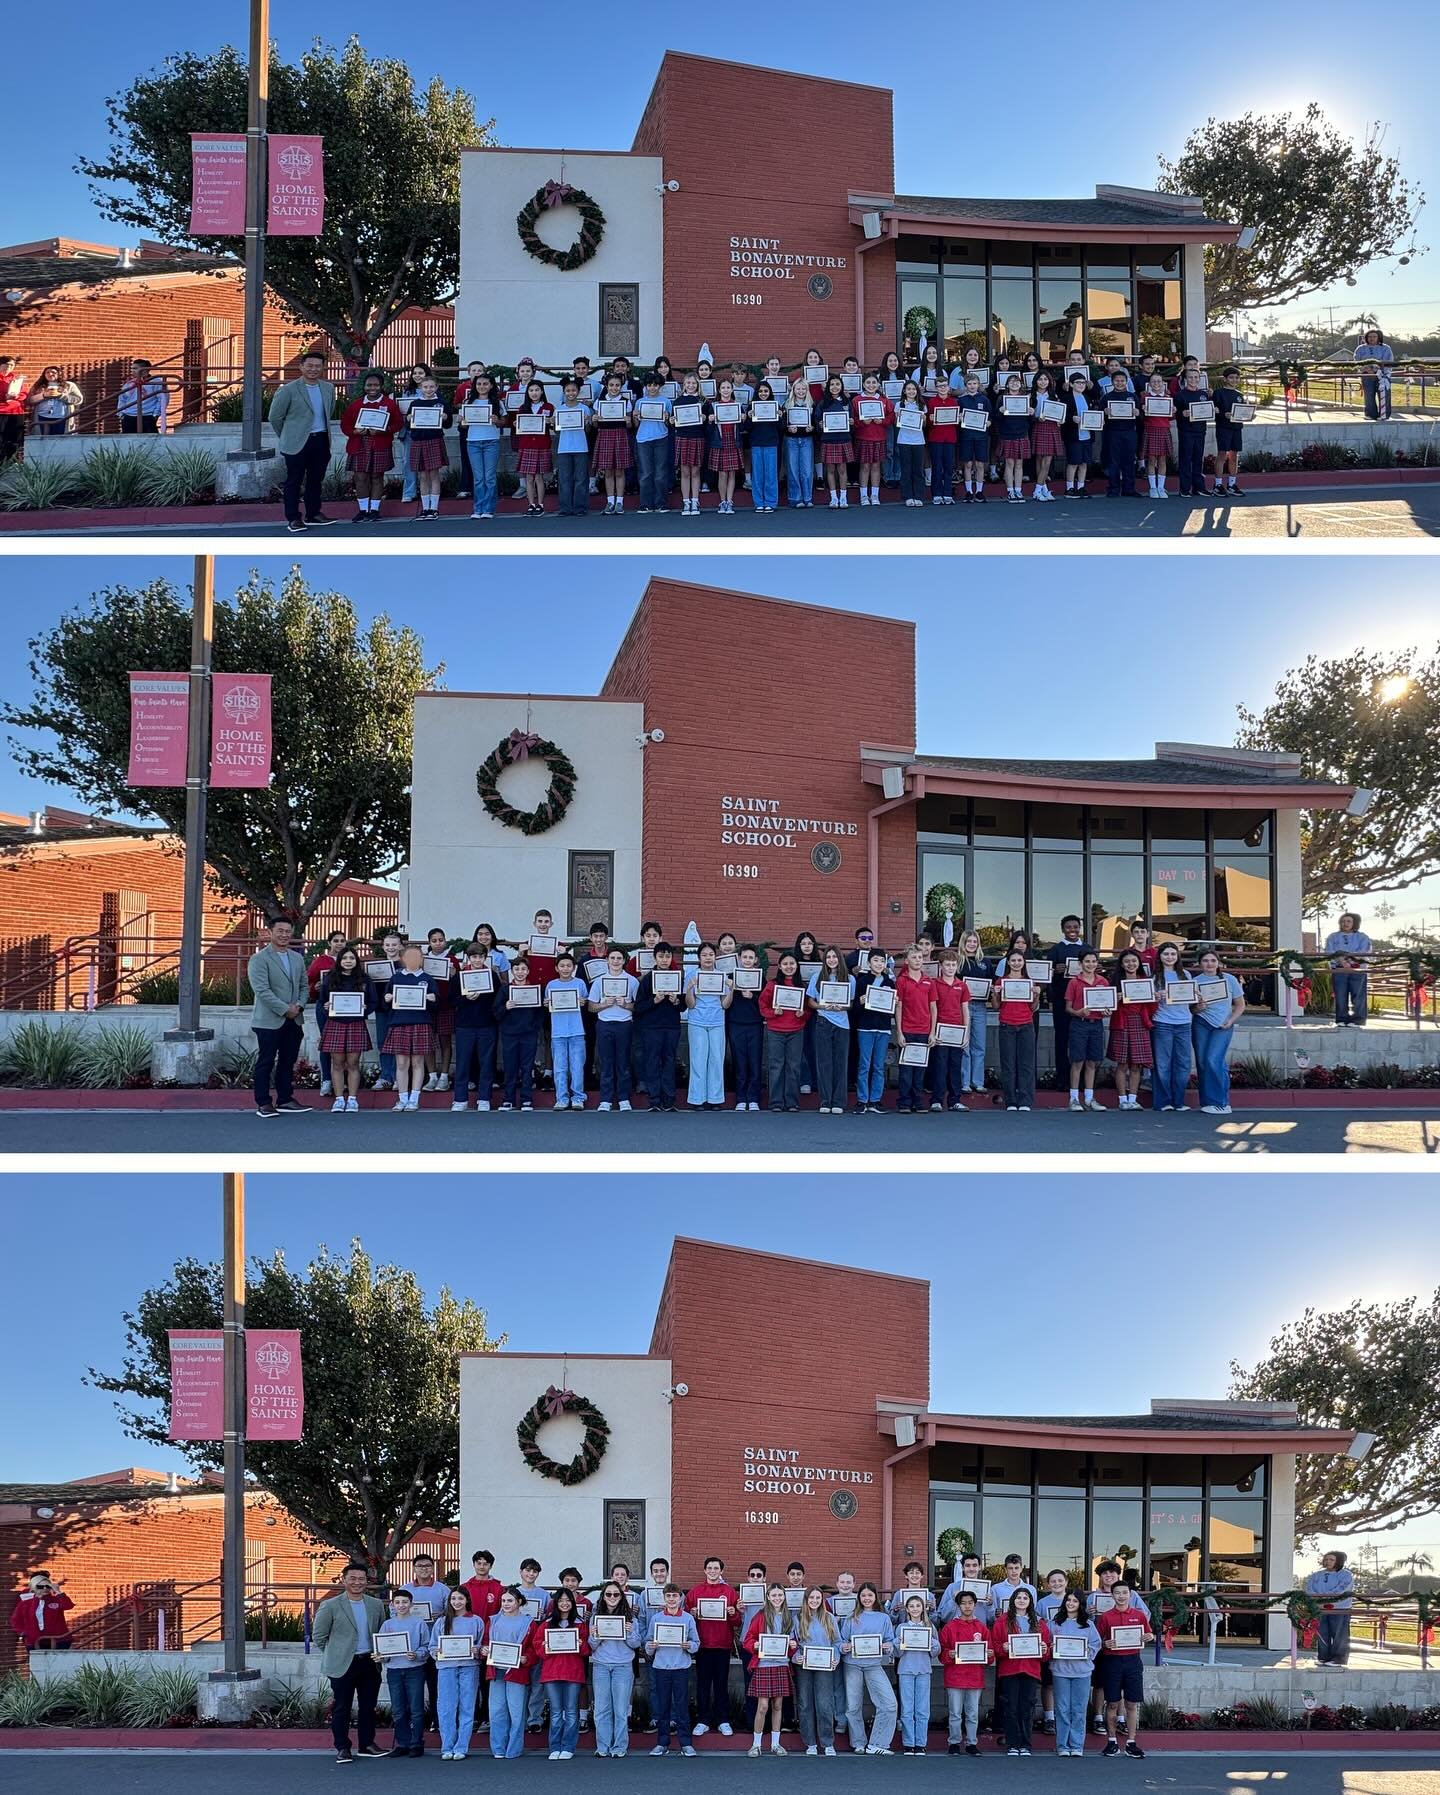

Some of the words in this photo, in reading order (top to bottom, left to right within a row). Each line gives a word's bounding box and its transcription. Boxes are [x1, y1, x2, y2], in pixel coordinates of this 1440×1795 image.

[276, 184, 316, 195] HOME
[272, 196, 288, 205] OF
[291, 196, 320, 206] THE
[272, 206, 318, 216] SAINTS
[730, 237, 780, 250] SAINT
[730, 251, 847, 268] BONAVENTURE
[730, 266, 795, 279] SCHOOL
[731, 294, 762, 305] 16390
[220, 730, 263, 741] HOME
[216, 742, 235, 752] OF
[237, 743, 266, 753] THE
[216, 754, 265, 766] SAINTS
[722, 796, 779, 812] SAINT
[722, 813, 858, 836] BONAVENTURE
[722, 831, 796, 848] SCHOOL
[722, 864, 758, 878] 16390
[1158, 870, 1176, 880] DAY
[1184, 870, 1196, 880] TO
[254, 1385, 295, 1396] HOME
[251, 1397, 268, 1406] OF
[272, 1398, 298, 1408] THE
[251, 1408, 297, 1419] SAINTS
[744, 1447, 799, 1462] SAINT
[744, 1463, 873, 1483] BONAVENTURE
[744, 1480, 815, 1495] SCHOOL
[745, 1511, 779, 1524] 16390
[1180, 1514, 1185, 1524] A
